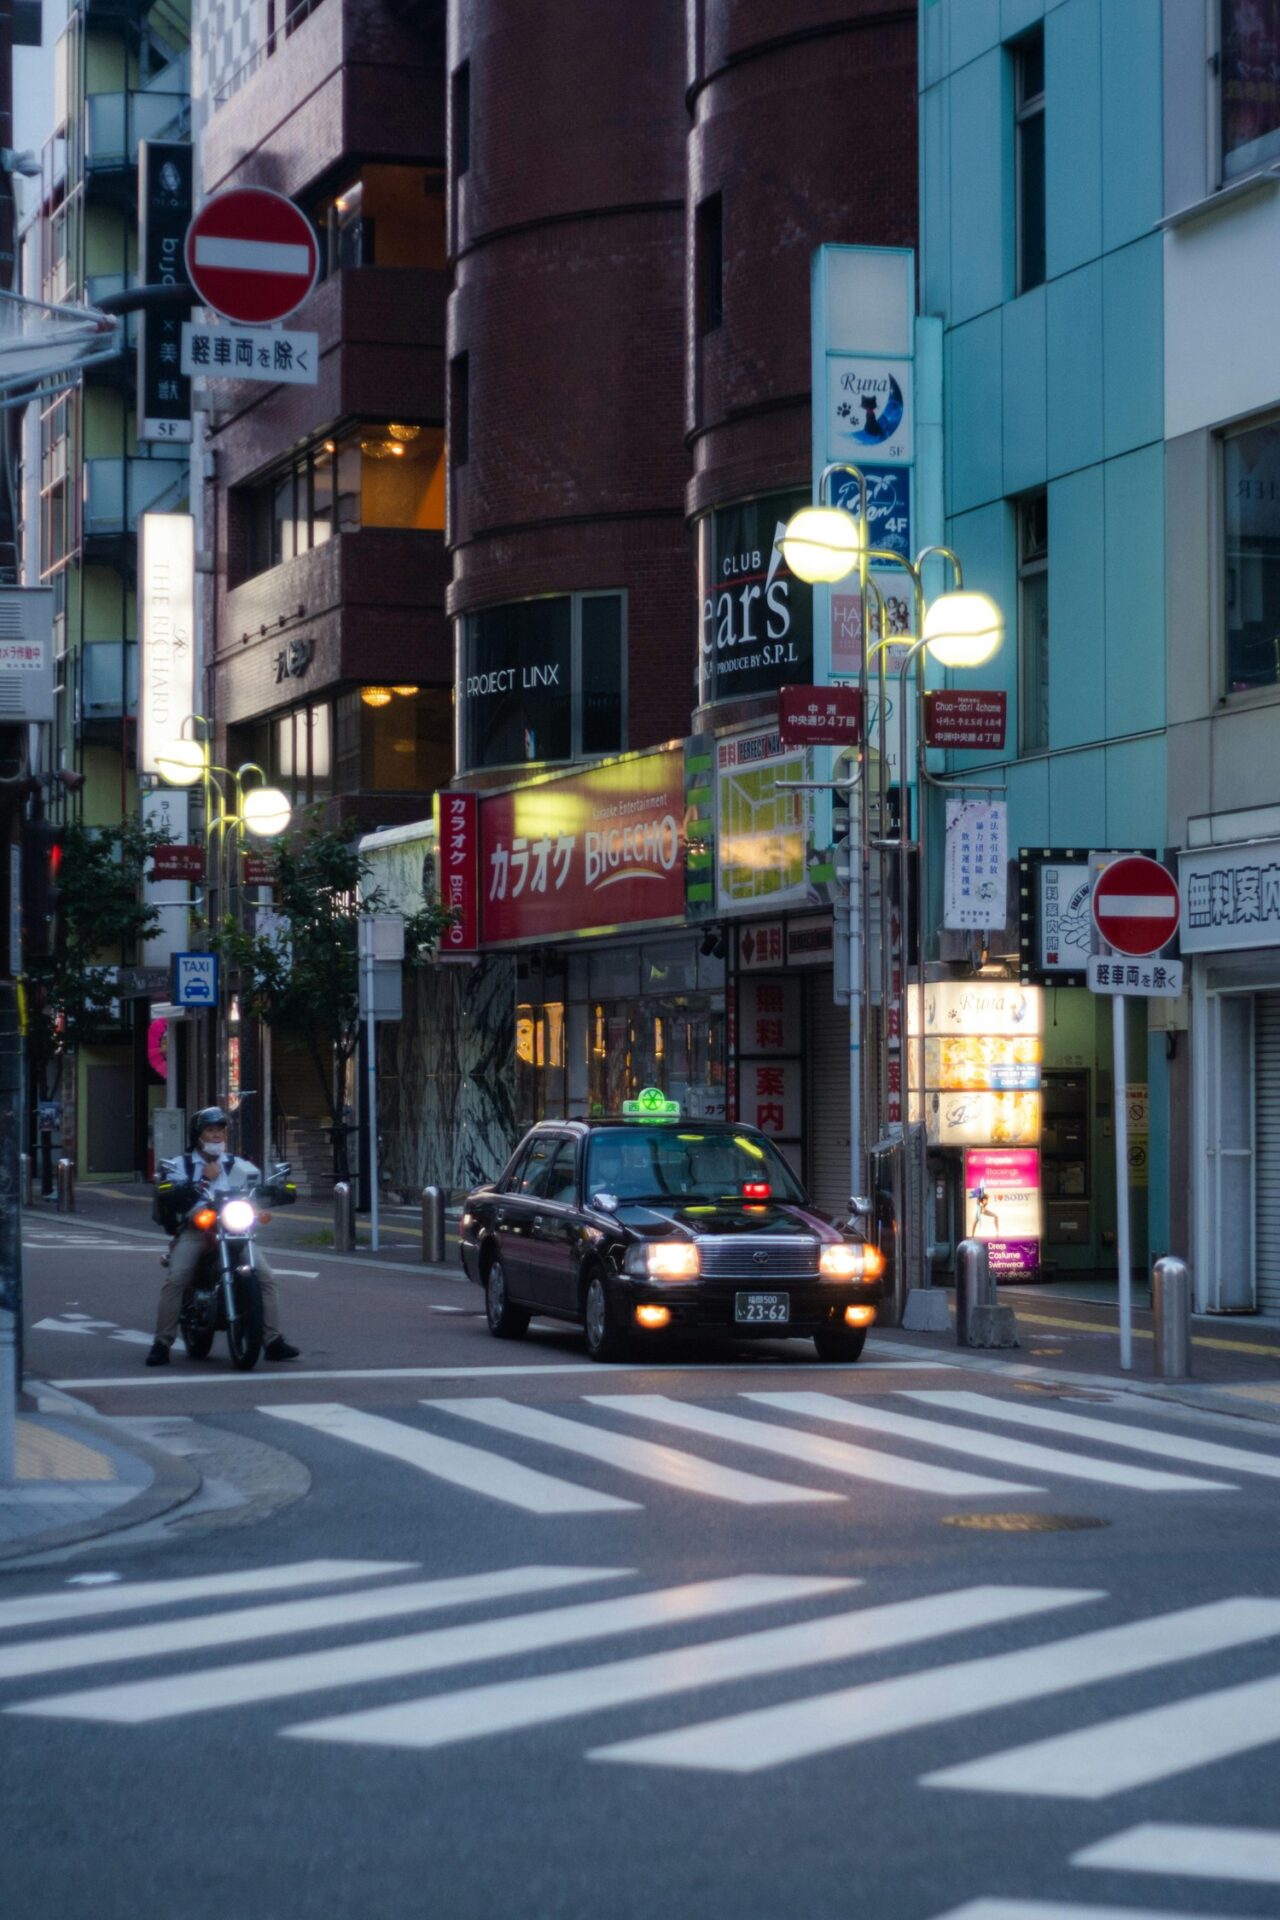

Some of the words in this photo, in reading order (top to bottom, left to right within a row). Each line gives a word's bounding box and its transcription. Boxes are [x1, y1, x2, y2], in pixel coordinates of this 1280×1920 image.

[191, 333, 308, 371] 軽車両を除く
[840, 372, 888, 395] Runa
[158, 423, 178, 436] 5F
[884, 517, 908, 533] 4F
[723, 550, 762, 576] CLUB
[152, 563, 169, 605] THE
[152, 615, 169, 725] RICHARD
[717, 656, 750, 676] PRODUCE
[750, 653, 763, 669] BY
[466, 668, 517, 698] PROJECT
[522, 663, 560, 689] LINX
[935, 702, 974, 712] Chuo-dori
[975, 702, 1001, 713] 4chome
[787, 714, 856, 727] 中央通り4丁目
[450, 798, 467, 866] カラオケ
[584, 830, 620, 887] BIG
[622, 814, 679, 870] ECHO
[489, 830, 576, 901] カラオケ
[756, 927, 781, 961] 無料
[182, 961, 209, 972] TAXI
[1096, 964, 1176, 989] 軽車両を除く
[986, 1168, 1019, 1177] Stockings
[988, 1242, 1007, 1251] Dress
[988, 1251, 1021, 1260] Costume
[747, 1304, 786, 1320] 23-62
